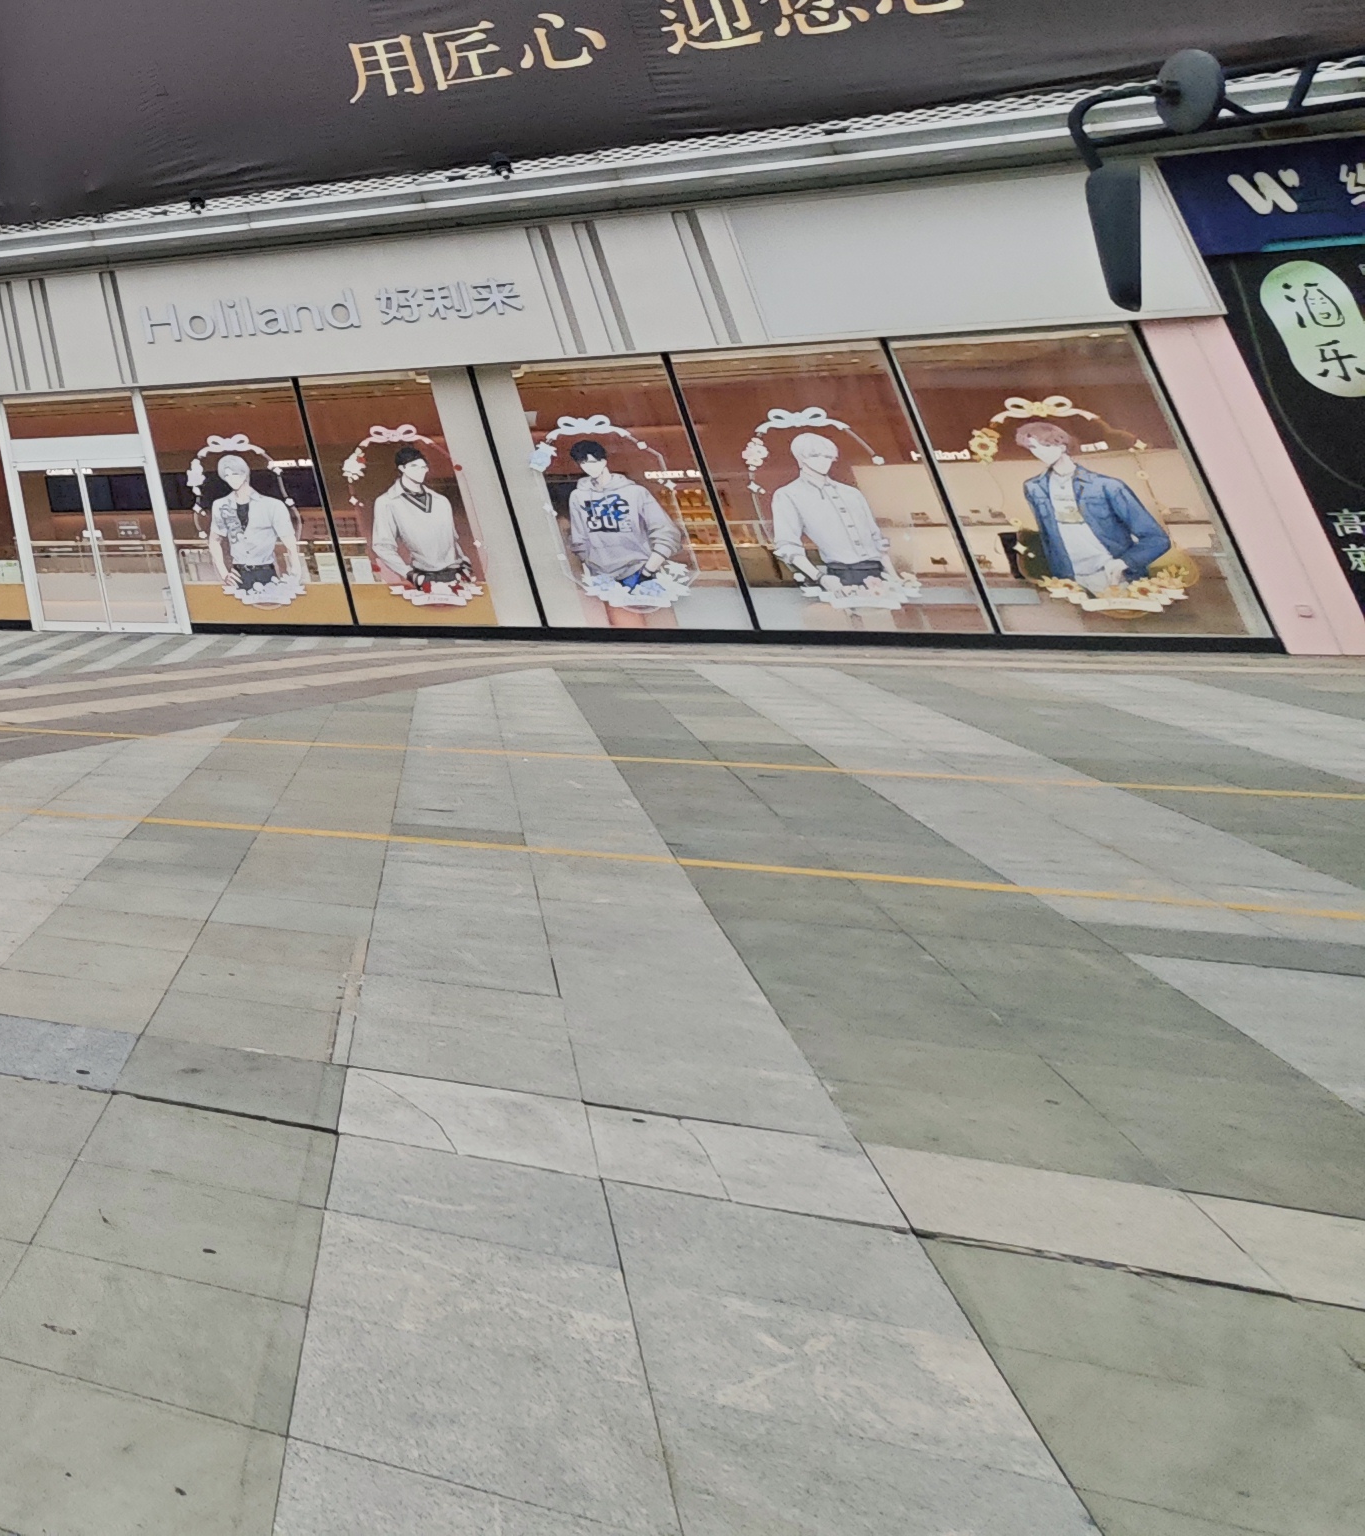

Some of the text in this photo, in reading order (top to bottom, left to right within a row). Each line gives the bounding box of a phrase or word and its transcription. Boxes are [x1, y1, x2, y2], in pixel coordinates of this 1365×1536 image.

[349, 13, 606, 105] 用匠心
[139, 278, 525, 344] Holiland 好利来
